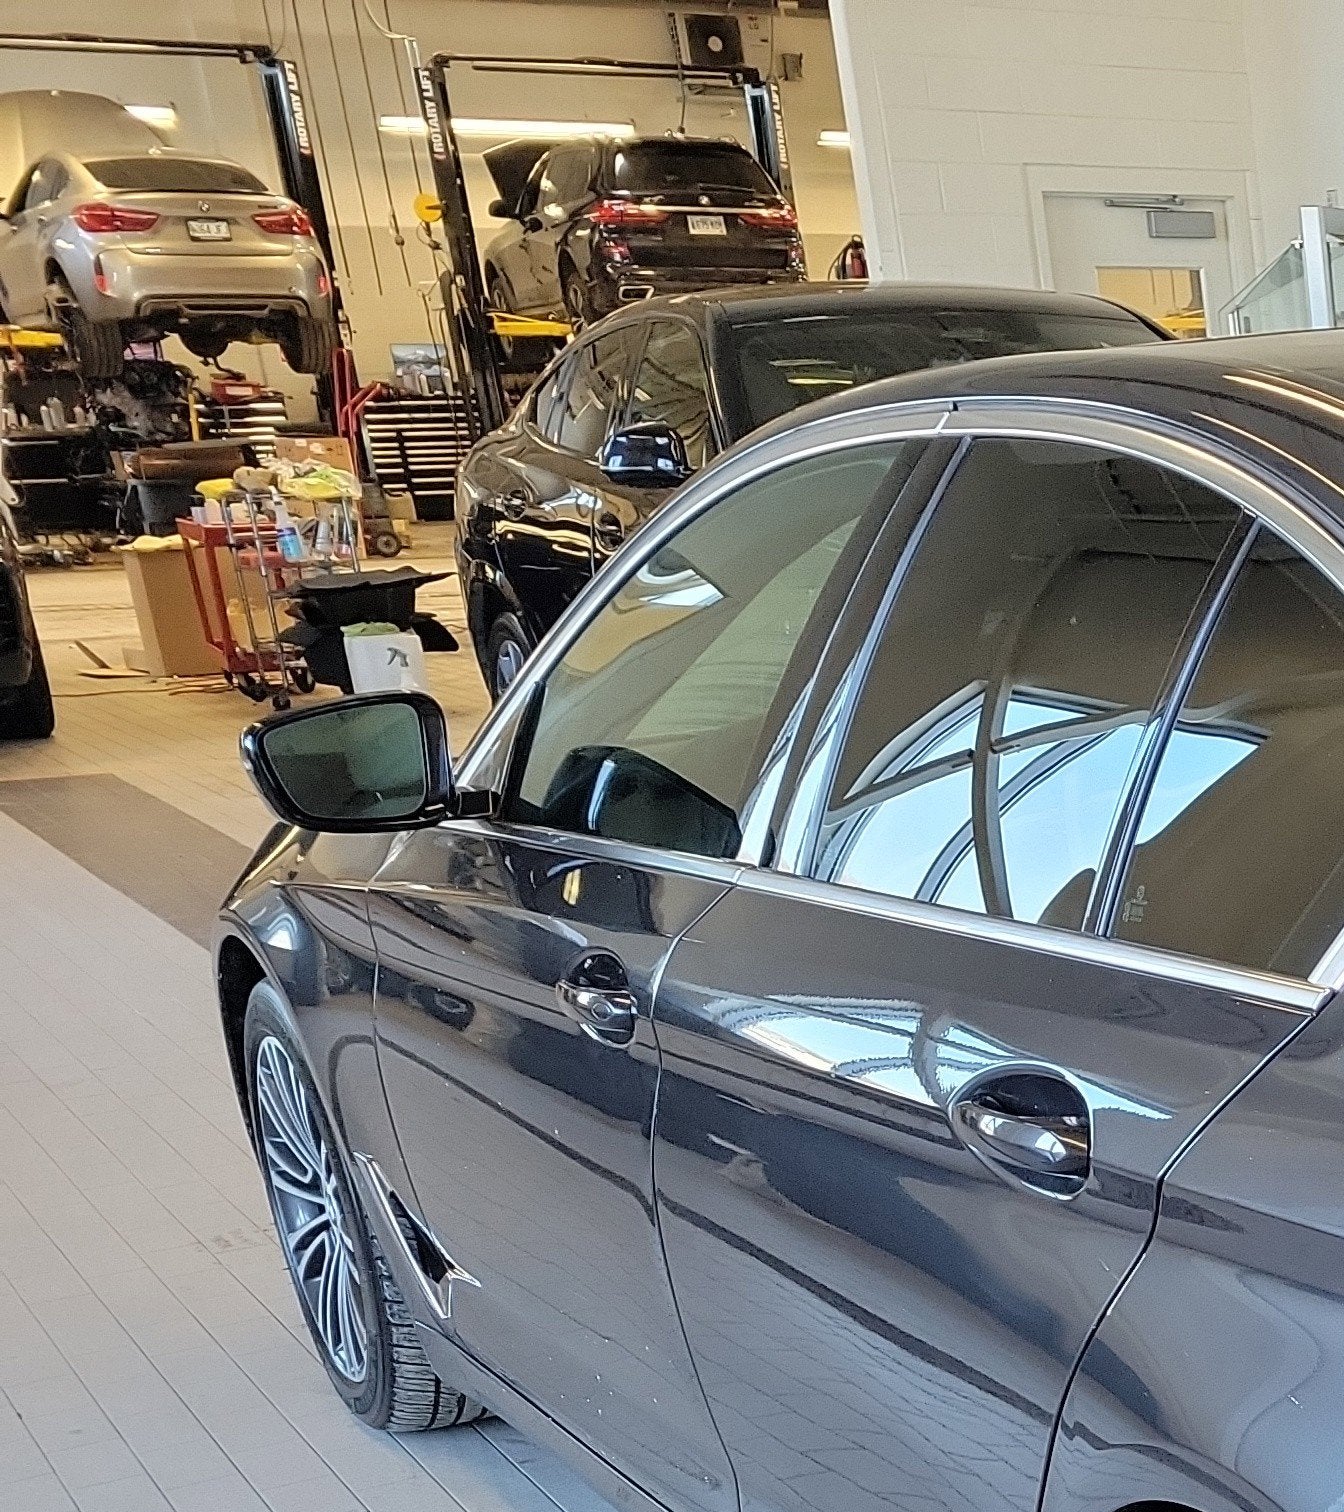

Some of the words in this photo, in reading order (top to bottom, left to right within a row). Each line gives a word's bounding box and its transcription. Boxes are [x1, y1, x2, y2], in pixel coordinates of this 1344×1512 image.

[283, 60, 299, 92] LIFT
[418, 68, 434, 98] LIFT
[770, 83, 781, 110] LIFT
[289, 92, 311, 149] ROTARY
[424, 99, 445, 153] ROTARY
[774, 112, 788, 162] ROTARY
